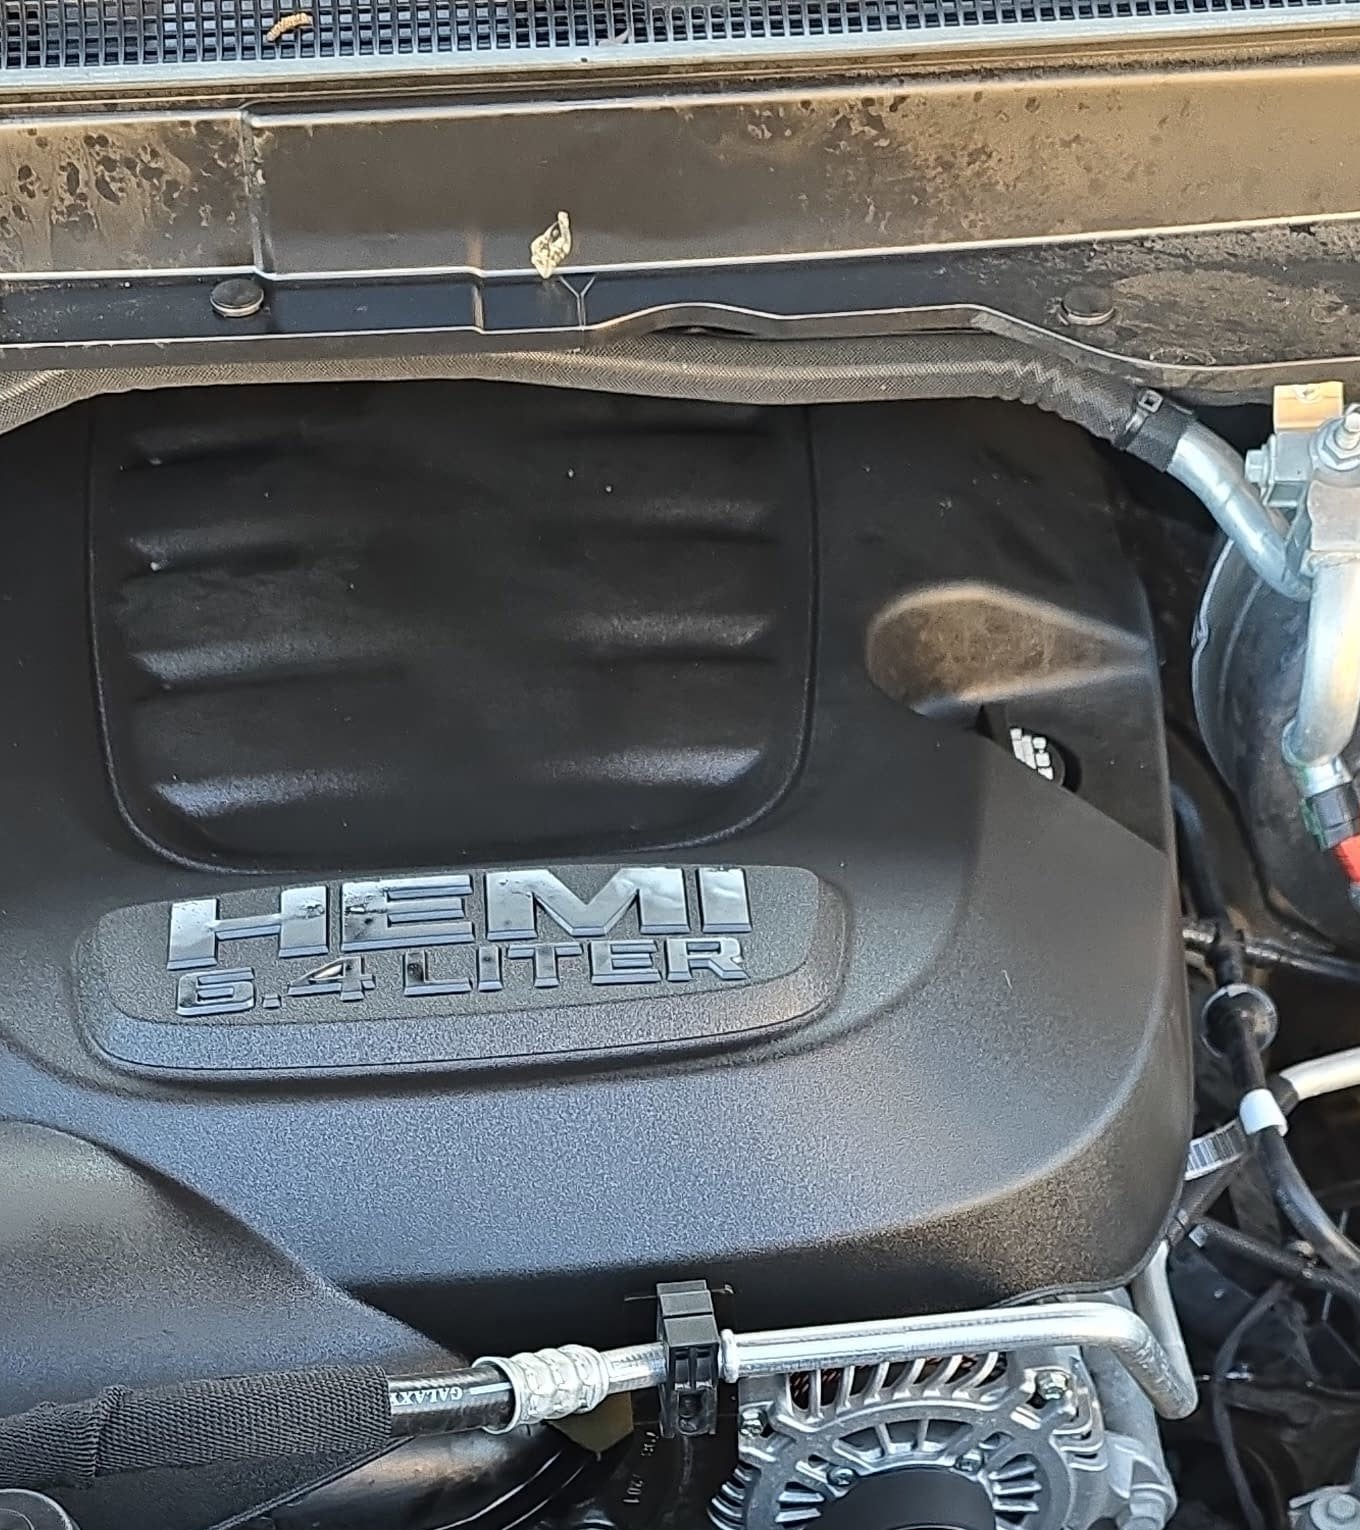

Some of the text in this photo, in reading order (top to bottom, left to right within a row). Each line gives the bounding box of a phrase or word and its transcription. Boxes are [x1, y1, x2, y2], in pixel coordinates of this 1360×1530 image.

[166, 866, 753, 971] HEMI
[175, 936, 750, 1017] 6.4 LITER
